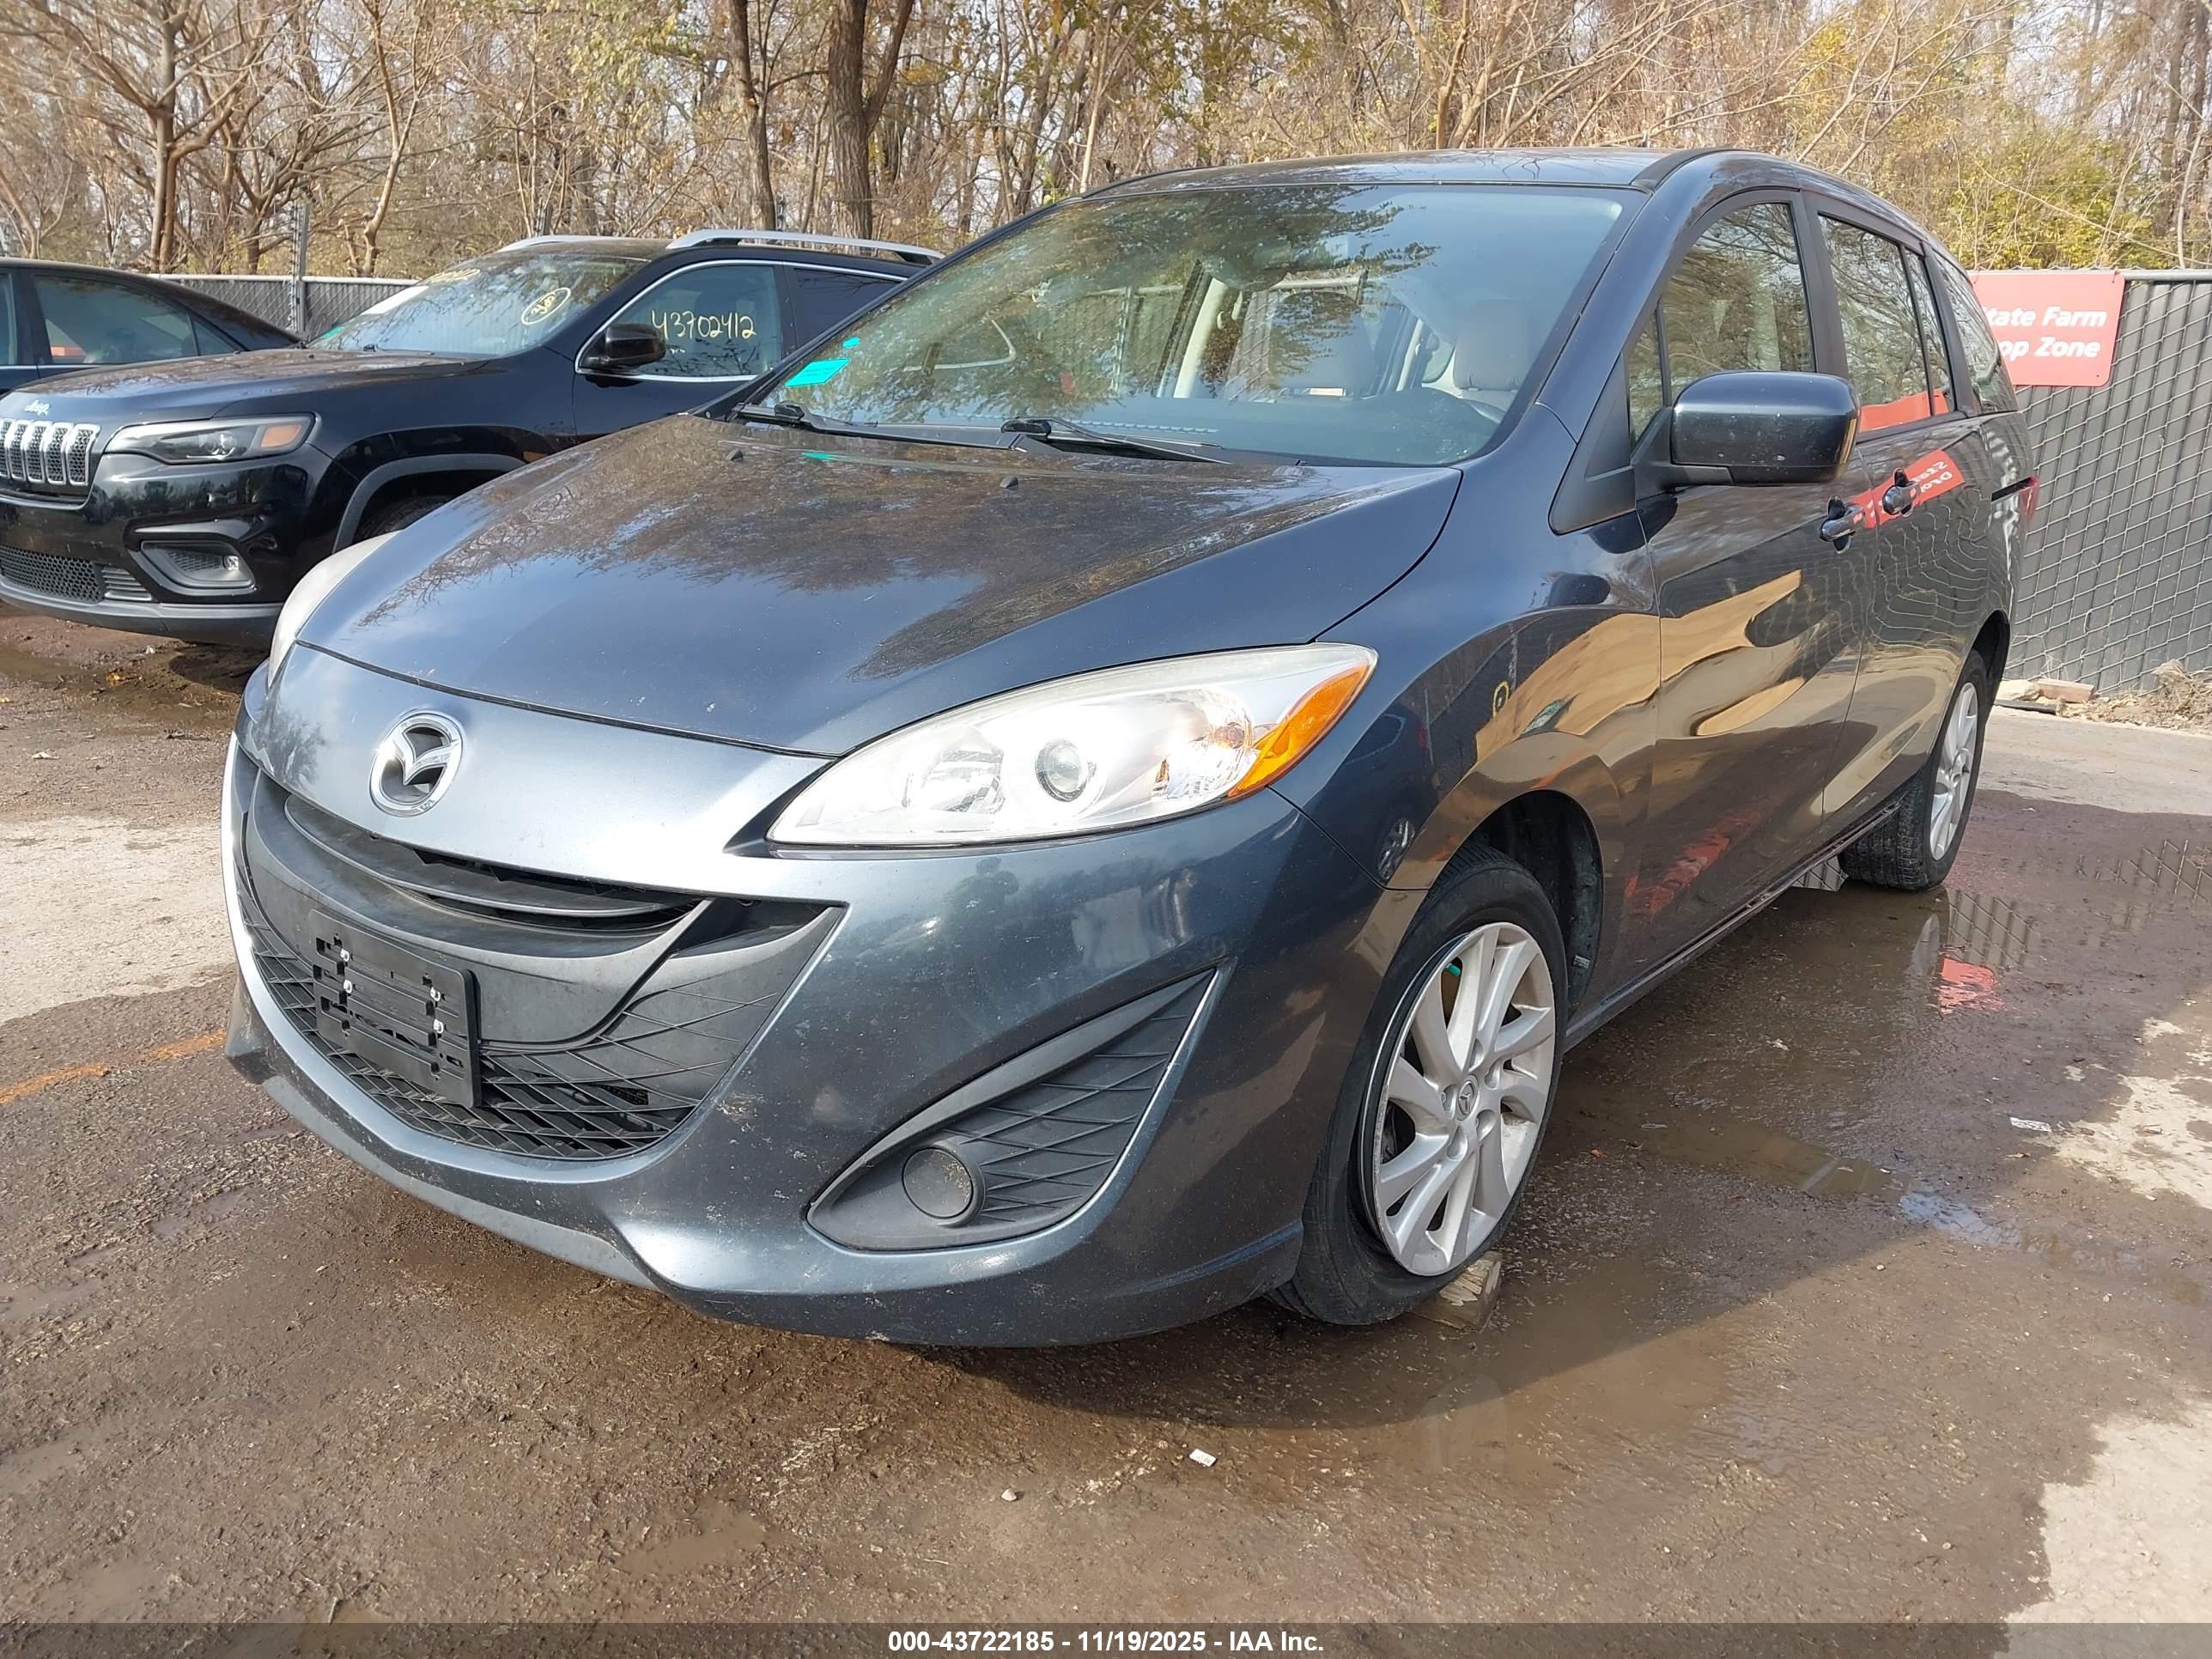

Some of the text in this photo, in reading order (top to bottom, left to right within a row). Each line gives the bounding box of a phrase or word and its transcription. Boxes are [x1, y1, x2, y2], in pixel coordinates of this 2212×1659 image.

[652, 309, 757, 340] 43702412
[1982, 306, 2108, 327] tate Farm
[1999, 336, 2101, 362] op Zone
